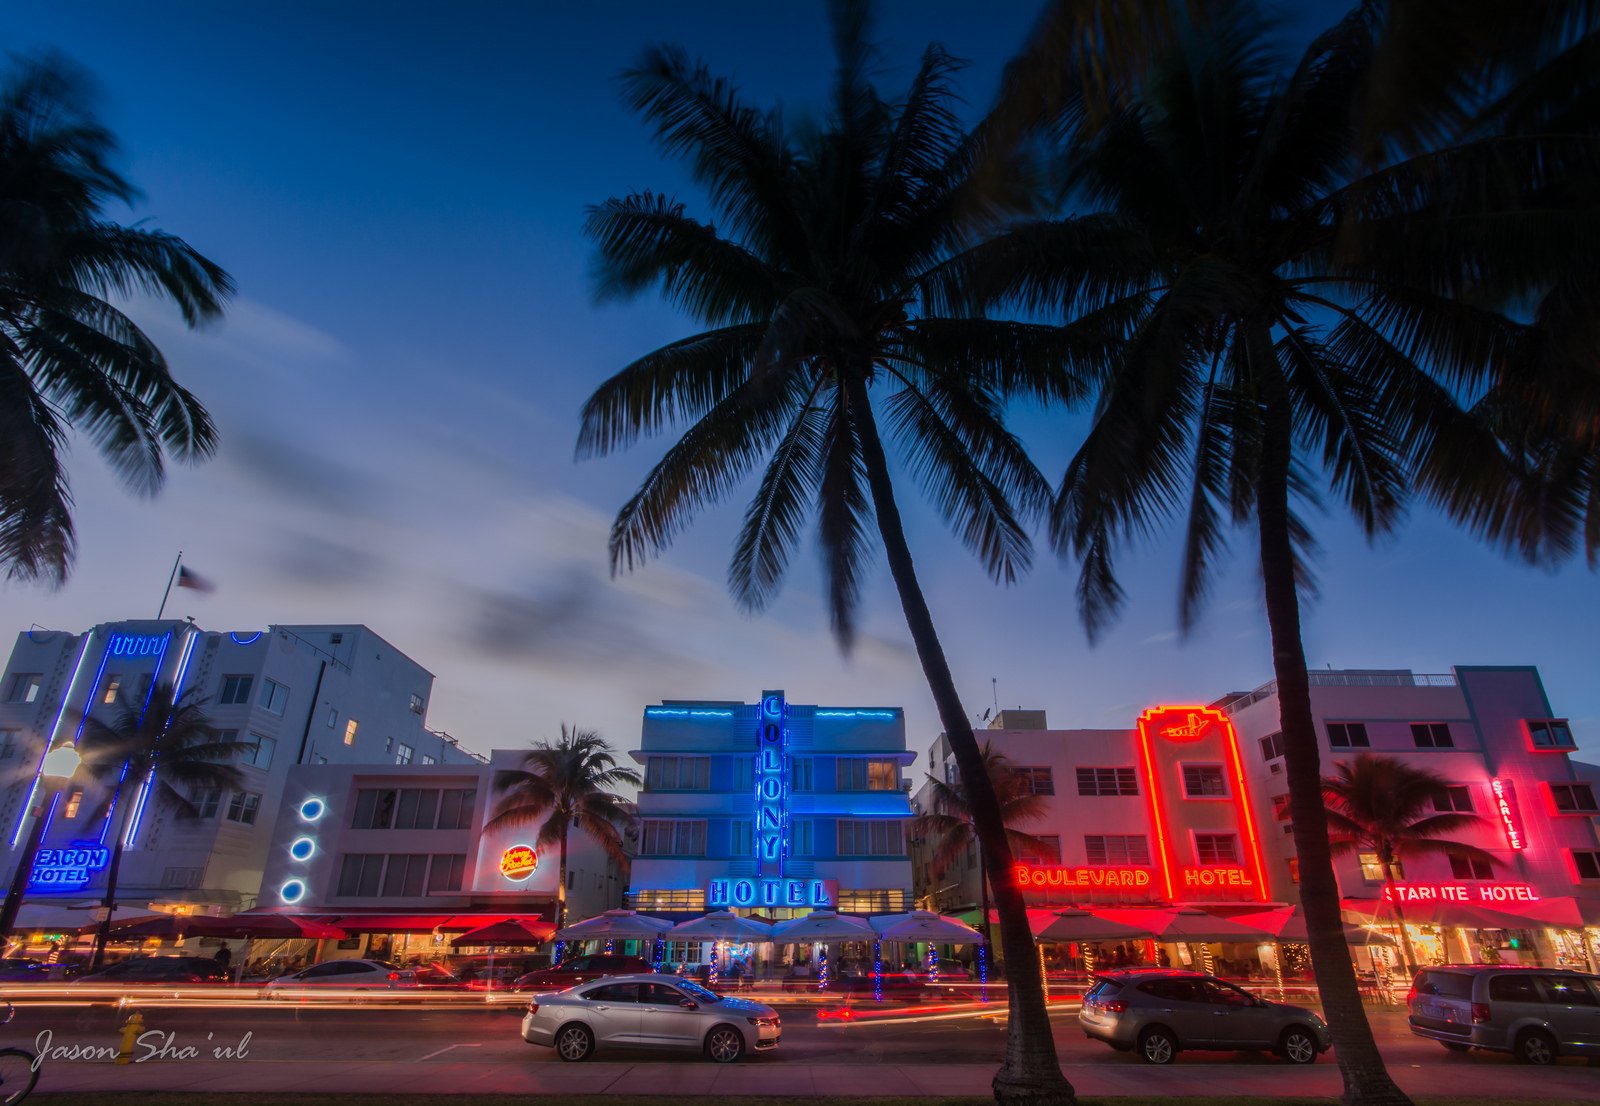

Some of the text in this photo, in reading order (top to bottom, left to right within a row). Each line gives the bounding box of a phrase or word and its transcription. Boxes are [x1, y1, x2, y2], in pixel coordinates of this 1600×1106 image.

[763, 696, 781, 859] COLONY
[1492, 780, 1521, 849] STARLITE
[34, 849, 107, 867] EACON
[1015, 865, 1252, 886] BOULEVARD HOTEL
[710, 880, 829, 904] HOTEL
[1480, 886, 1539, 901] HOTEL
